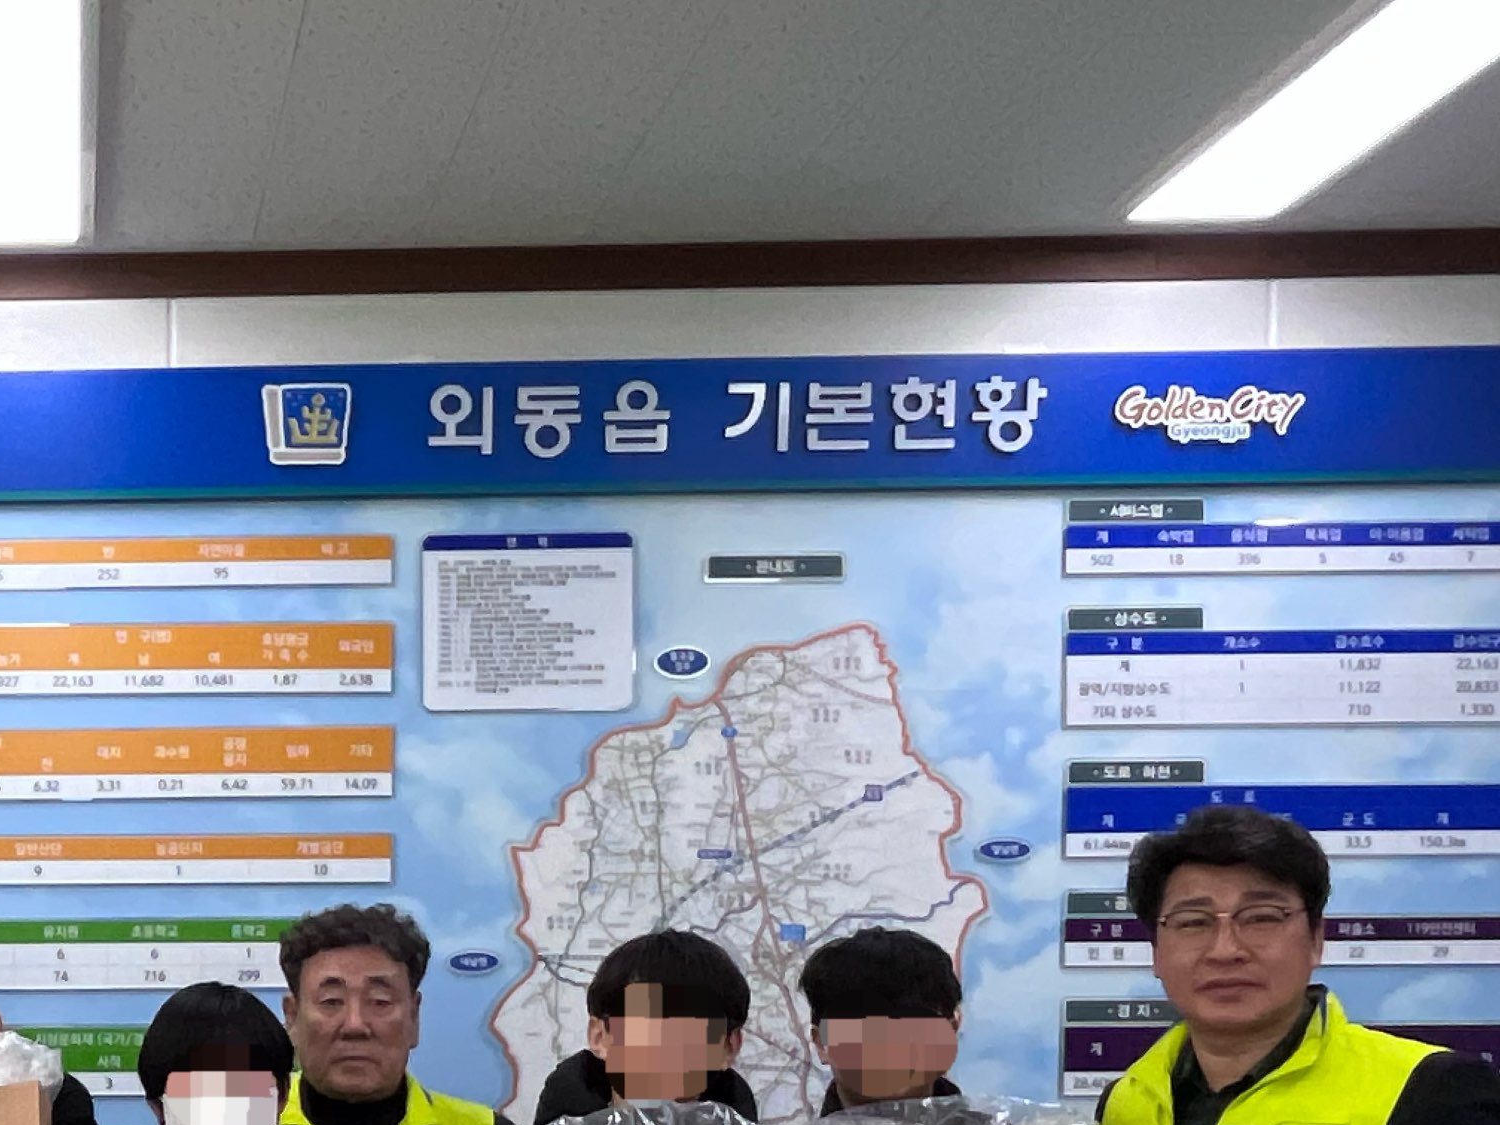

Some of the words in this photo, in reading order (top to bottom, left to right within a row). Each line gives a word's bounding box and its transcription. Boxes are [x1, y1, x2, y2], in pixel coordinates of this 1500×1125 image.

[427, 379, 672, 459] 외동읍
[723, 375, 1049, 453] 기본현황
[1116, 387, 1227, 427] Golden
[1228, 387, 1304, 433] City
[1170, 422, 1248, 440] Gyeongju
[1109, 503, 1164, 518] 서비스업
[1169, 553, 1185, 566] 18
[96, 568, 121, 582] 252
[212, 566, 230, 580] 95
[1113, 611, 1158, 627] 상수도
[52, 674, 95, 689] 22,163
[124, 674, 165, 689] 11,682
[193, 674, 235, 688] 10,481
[1347, 703, 1373, 717] 710
[32, 780, 61, 794] 6.32
[96, 779, 122, 793] 3.31
[157, 778, 184, 792] 0.21
[33, 864, 43, 878] 9
[55, 949, 66, 961] 6
[149, 948, 160, 960] 6
